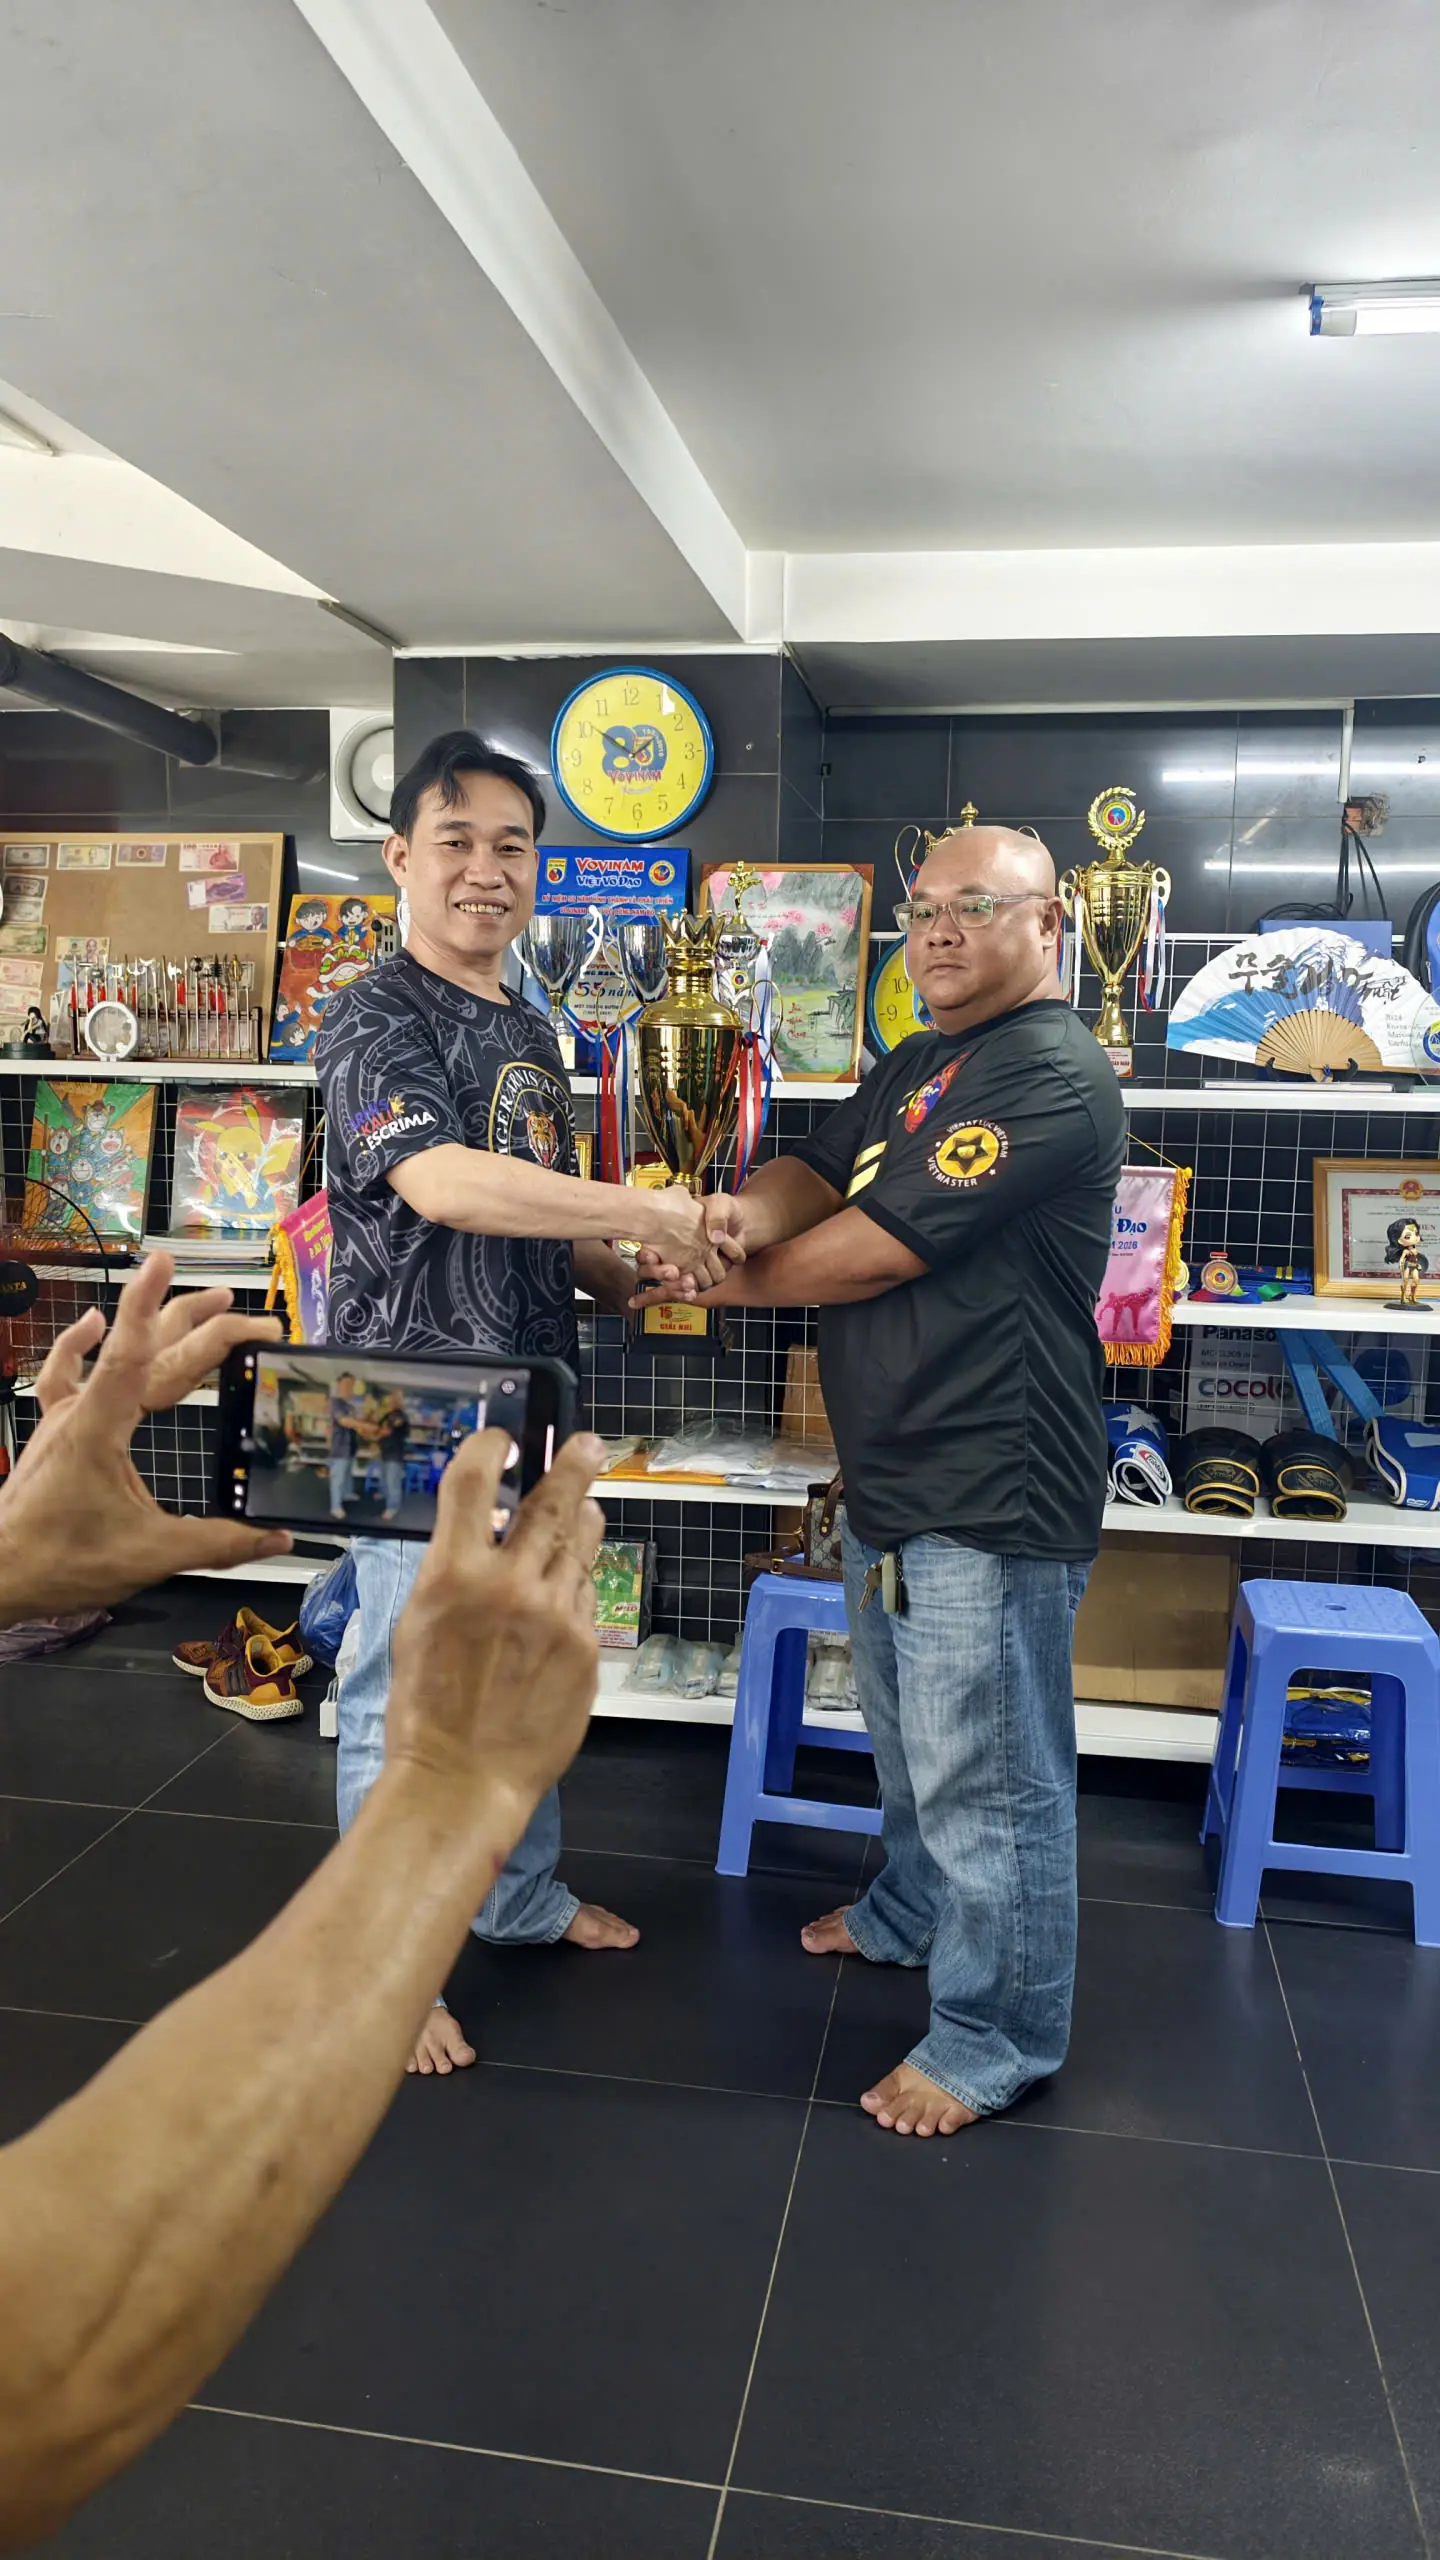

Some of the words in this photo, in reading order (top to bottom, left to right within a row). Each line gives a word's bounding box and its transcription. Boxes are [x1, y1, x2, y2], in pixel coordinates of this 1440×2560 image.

[623, 687, 639, 706] 12
[596, 698, 609, 717] 11
[576, 721, 593, 738] 10
[673, 713, 684, 731] 2
[571, 749, 582, 767] 9
[684, 743, 695, 760] 3
[582, 778, 593, 795] 8
[677, 772, 686, 789] 4
[604, 797, 614, 815] 7
[632, 802, 643, 821] 6
[658, 794, 668, 812] 5
[575, 857, 645, 875] VOVINAM
[574, 981, 606, 998] 55
[893, 976, 909, 993] 10
[887, 1004, 898, 1021] 9
[496, 1095, 513, 1154] IGER
[506, 1069, 538, 1100] ARNIS
[361, 1109, 393, 1137] KALI
[366, 1111, 437, 1151] ESCRIMA
[1202, 1325, 1277, 1341] Panaso
